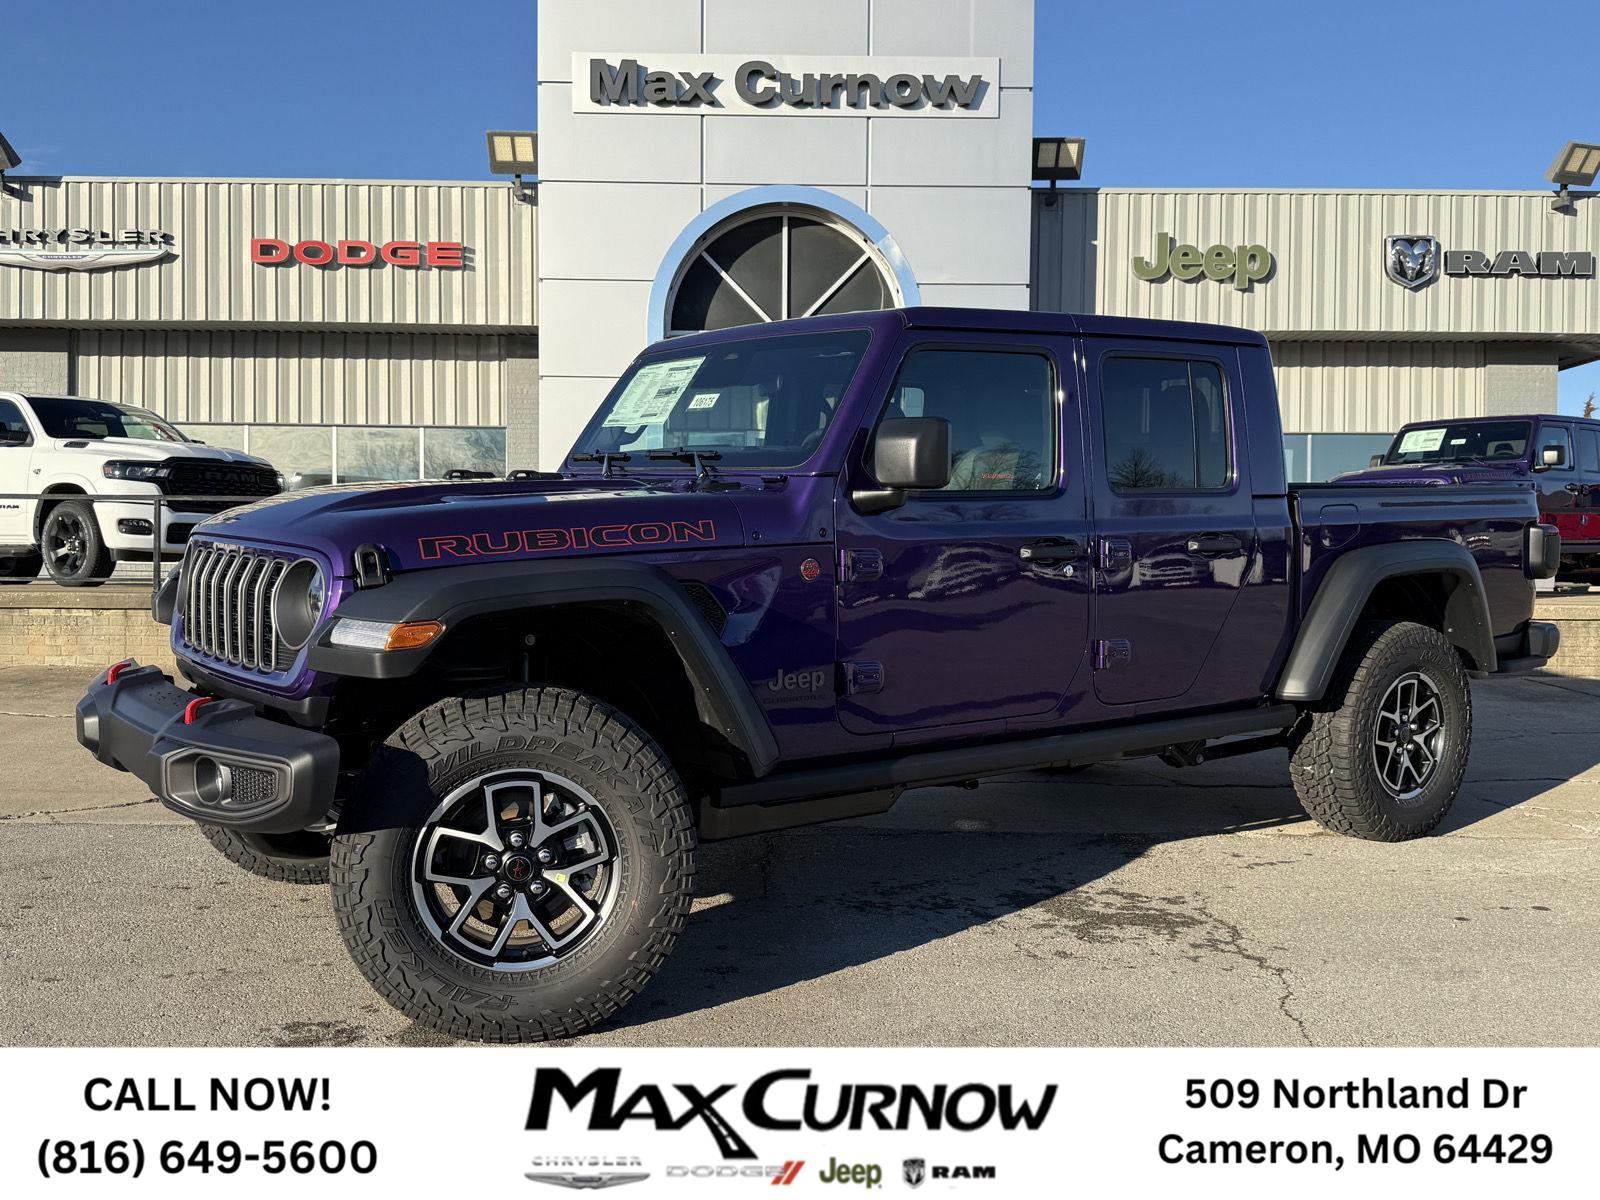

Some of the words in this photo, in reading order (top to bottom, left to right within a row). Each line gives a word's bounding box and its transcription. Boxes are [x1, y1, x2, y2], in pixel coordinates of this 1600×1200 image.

[589, 58, 716, 104] Max
[734, 60, 983, 107] Curnow
[0, 228, 166, 243] HRYSLER
[251, 238, 463, 268] DODGE
[1132, 231, 1272, 291] Jeep
[1445, 250, 1595, 275] RAM
[205, 472, 257, 483] RAM
[418, 520, 716, 560] RUBICON
[768, 669, 825, 692] Jeep
